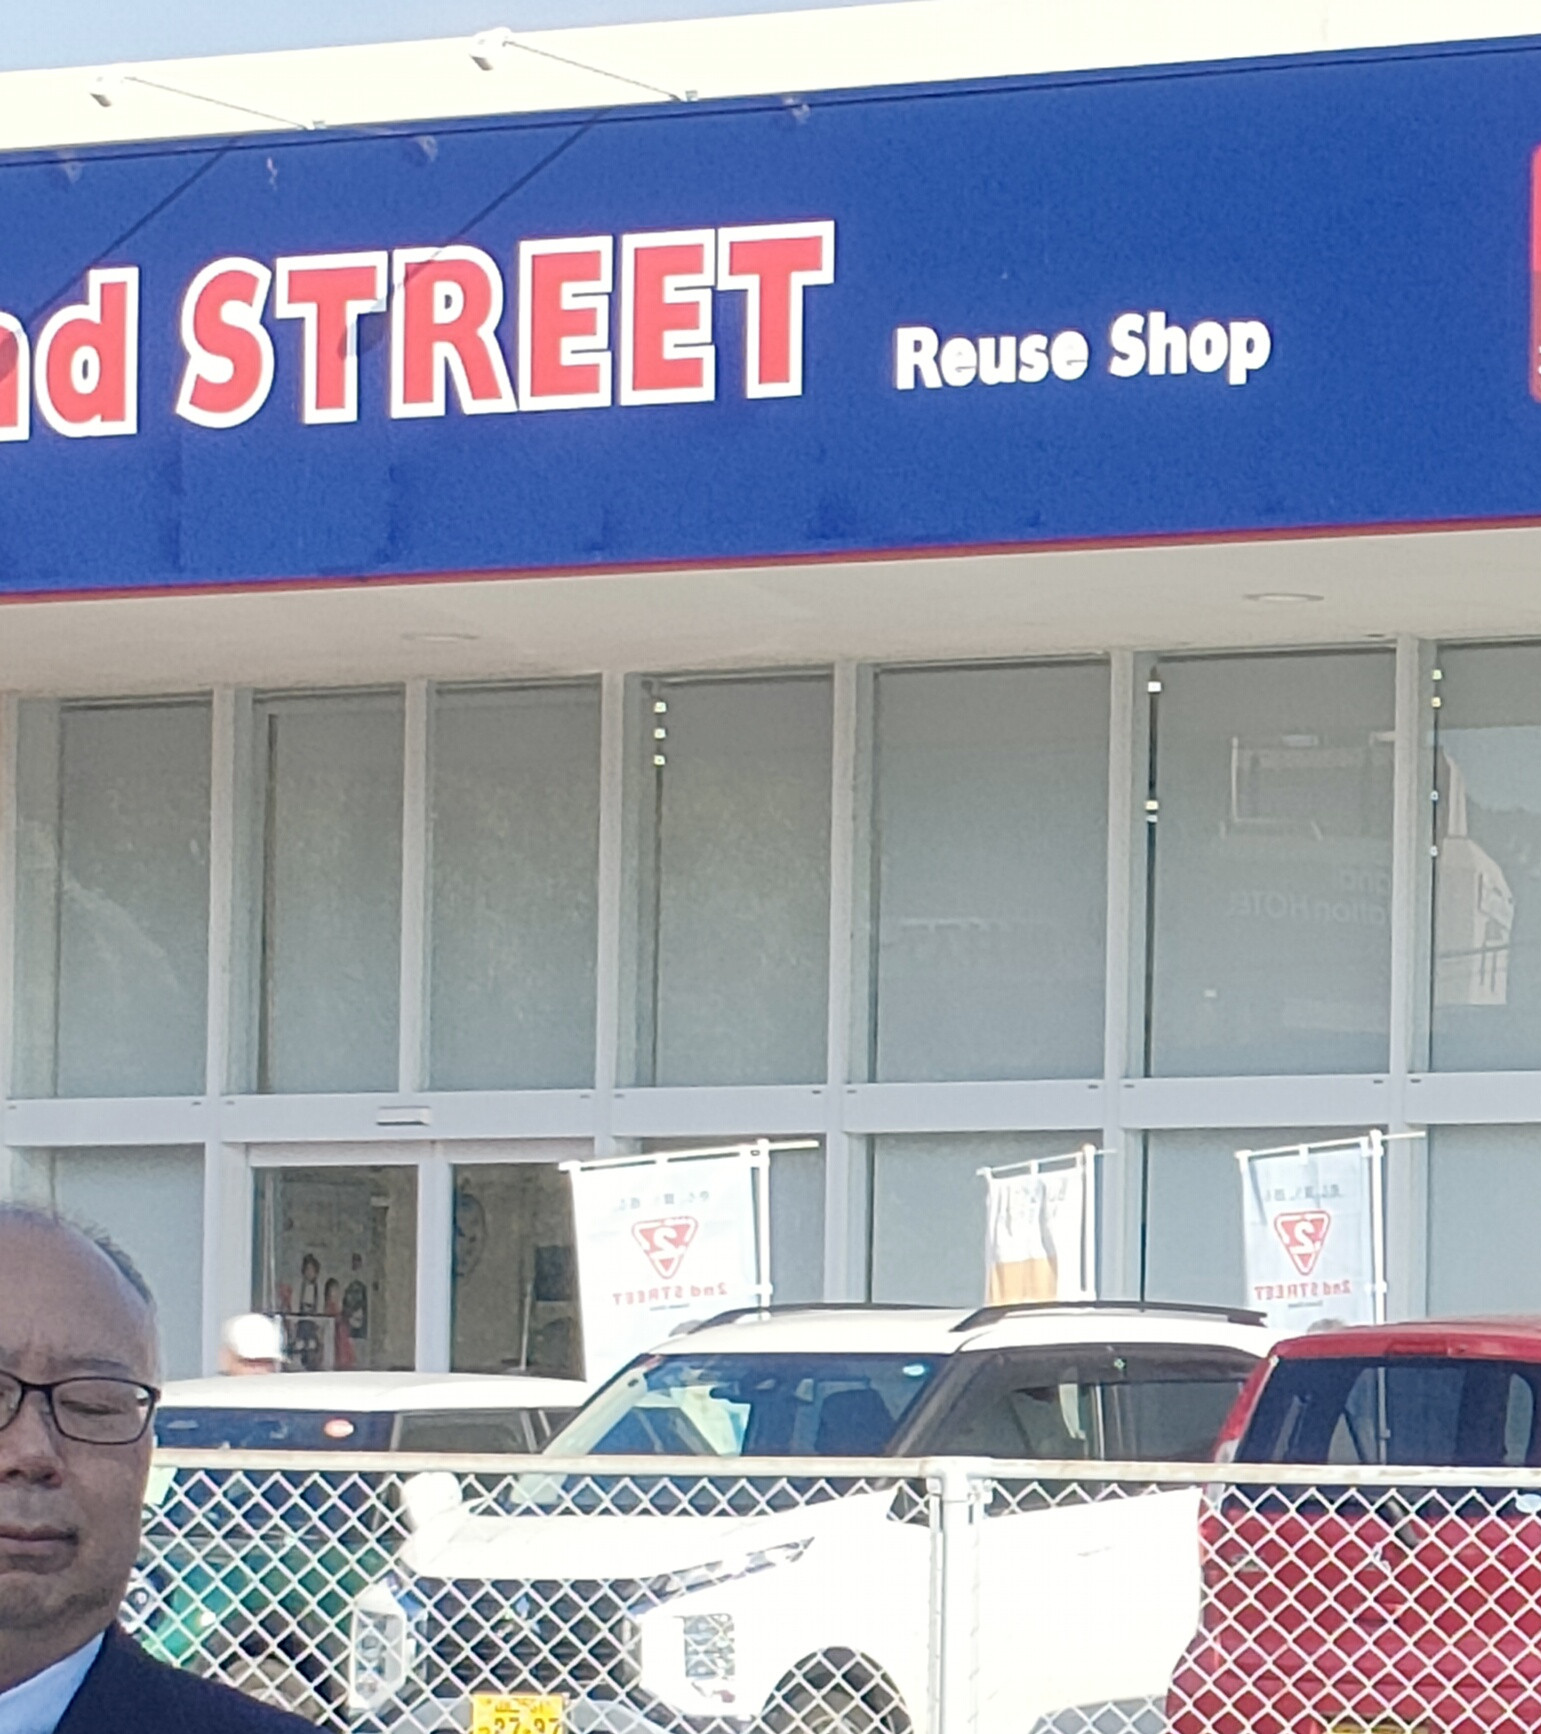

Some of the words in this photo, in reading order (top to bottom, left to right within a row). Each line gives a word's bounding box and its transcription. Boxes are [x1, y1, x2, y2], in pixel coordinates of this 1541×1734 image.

[177, 220, 836, 429] STREET
[895, 325, 1090, 390] Reuse
[1109, 311, 1272, 386] Shop
